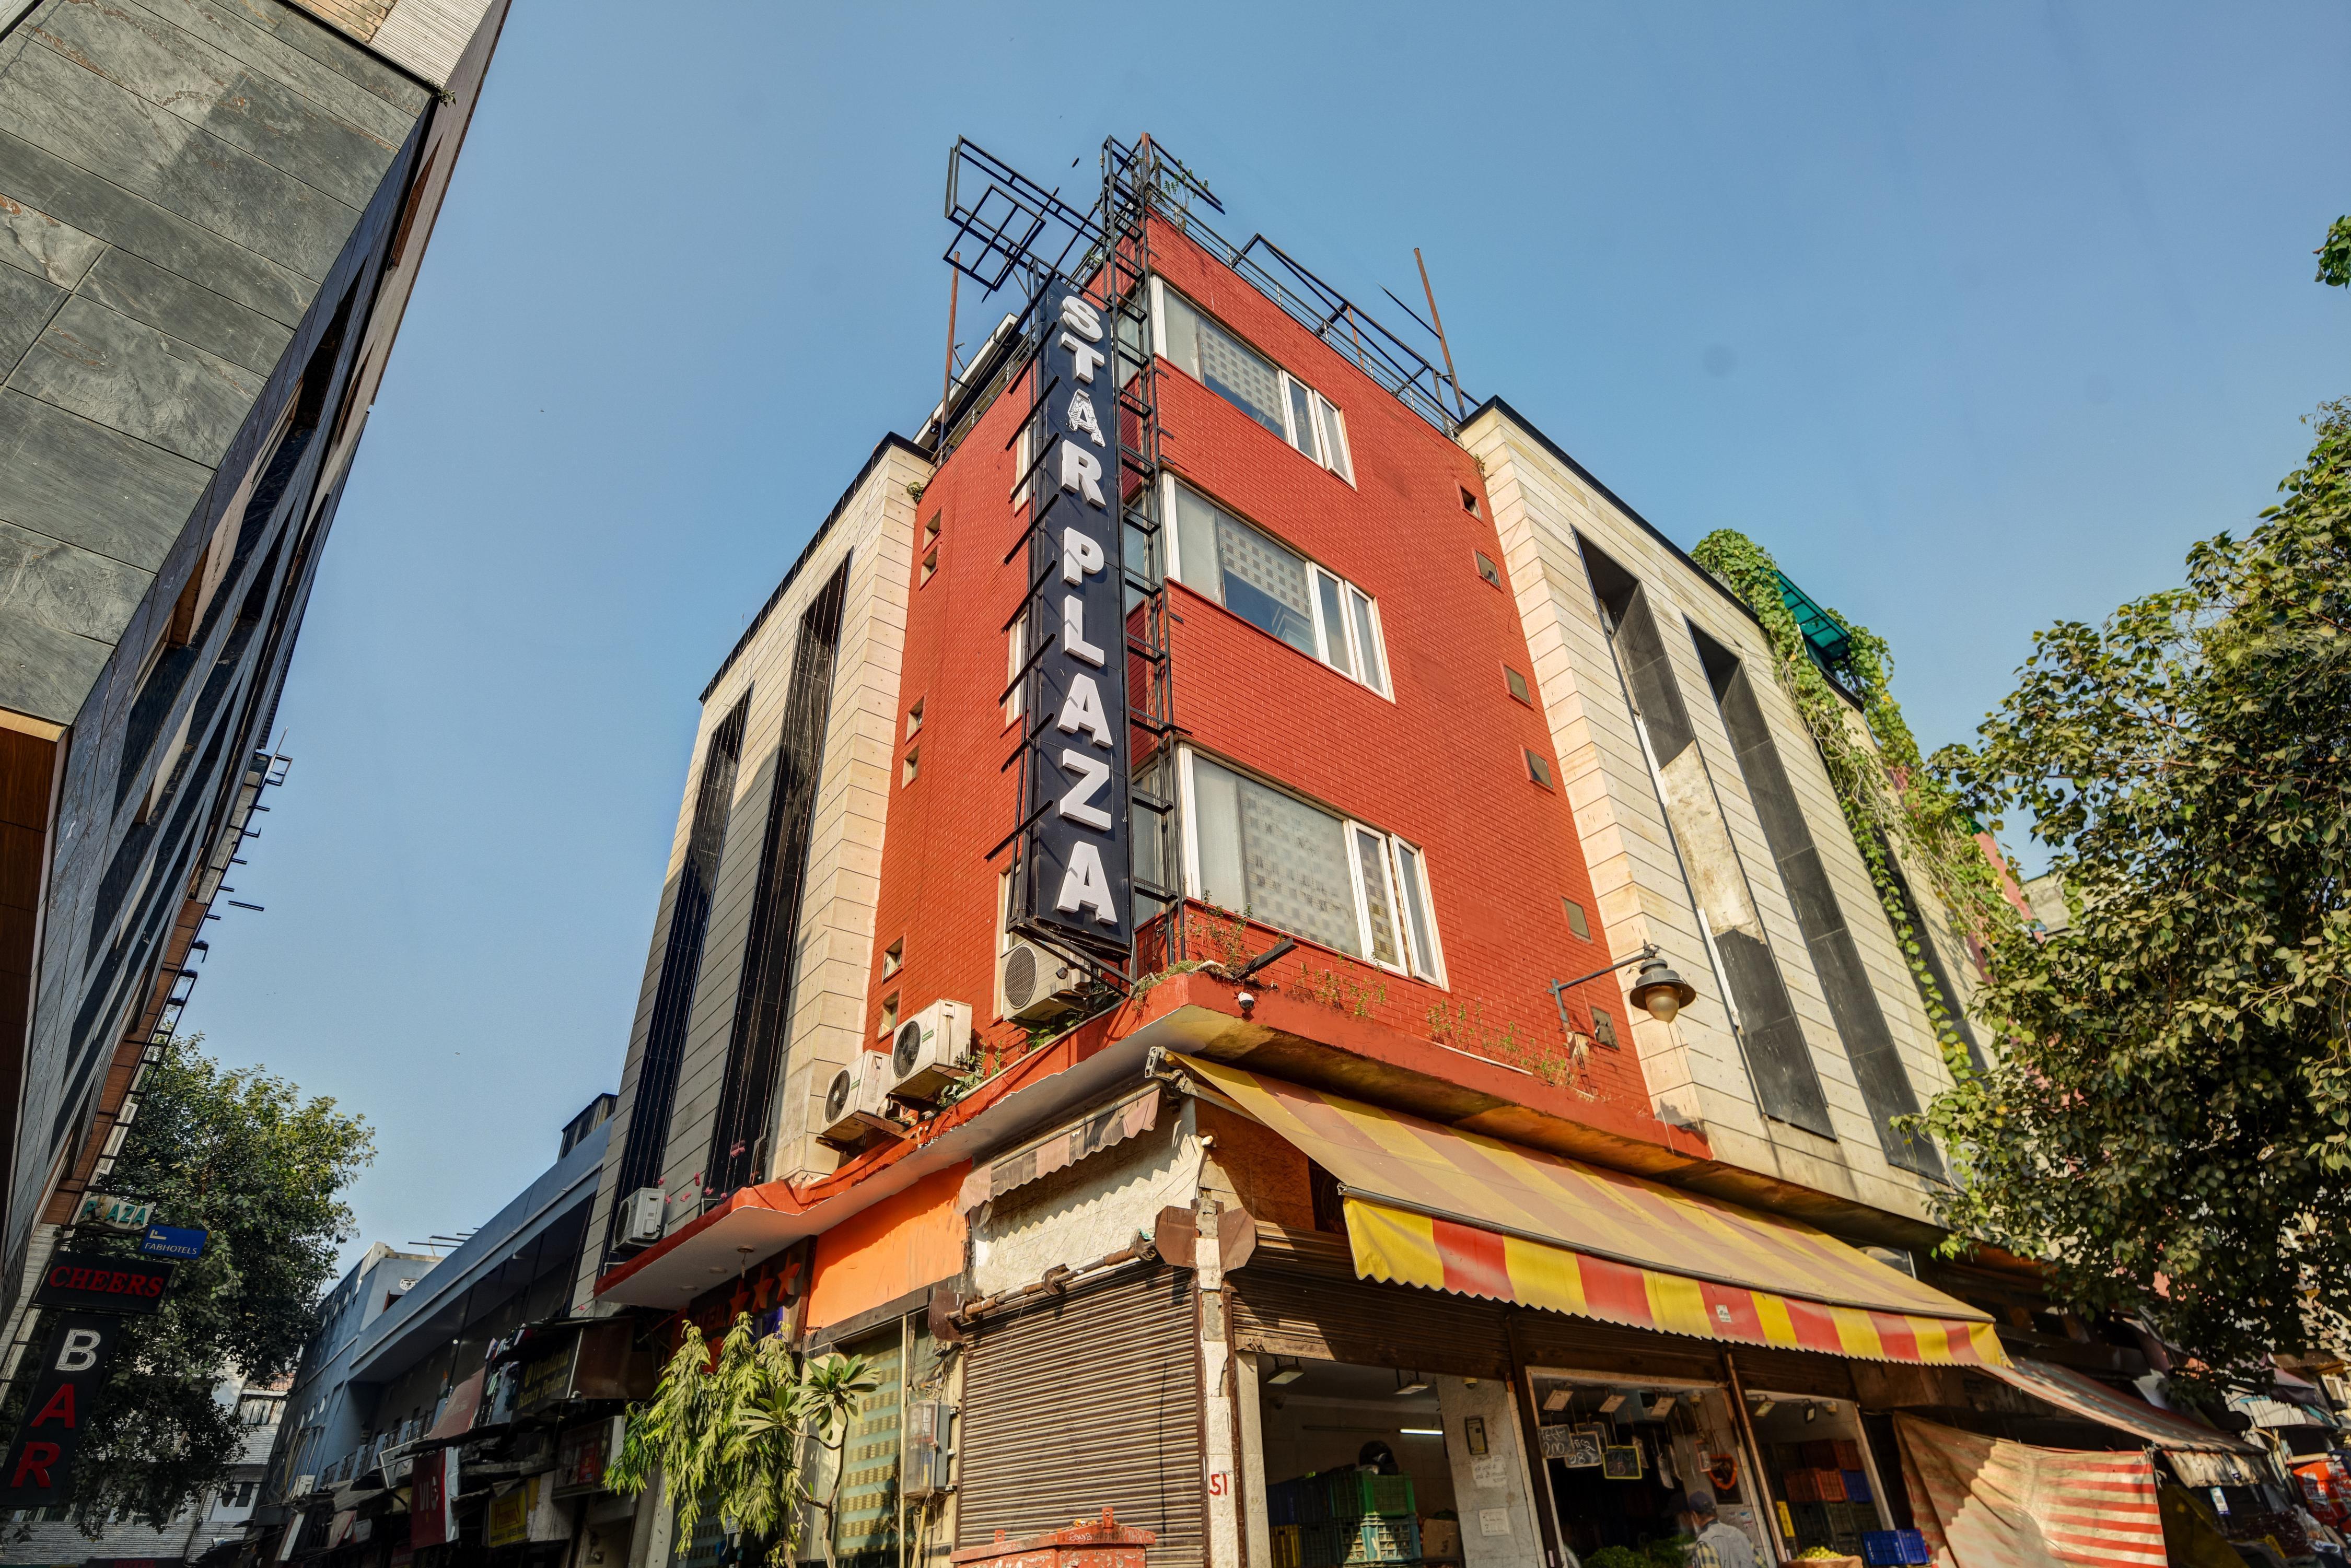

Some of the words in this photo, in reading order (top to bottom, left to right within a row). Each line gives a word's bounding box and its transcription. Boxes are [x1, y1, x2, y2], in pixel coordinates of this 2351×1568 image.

[1061, 296, 1107, 508] STAR
[1056, 526, 1118, 927] PLAZA
[82, 1200, 146, 1224] PAZA
[144, 1242, 197, 1255] FABHOTELS
[49, 1266, 166, 1298] CHEERS
[9, 1328, 101, 1488] BAR
[1209, 1473, 1227, 1496] 51
